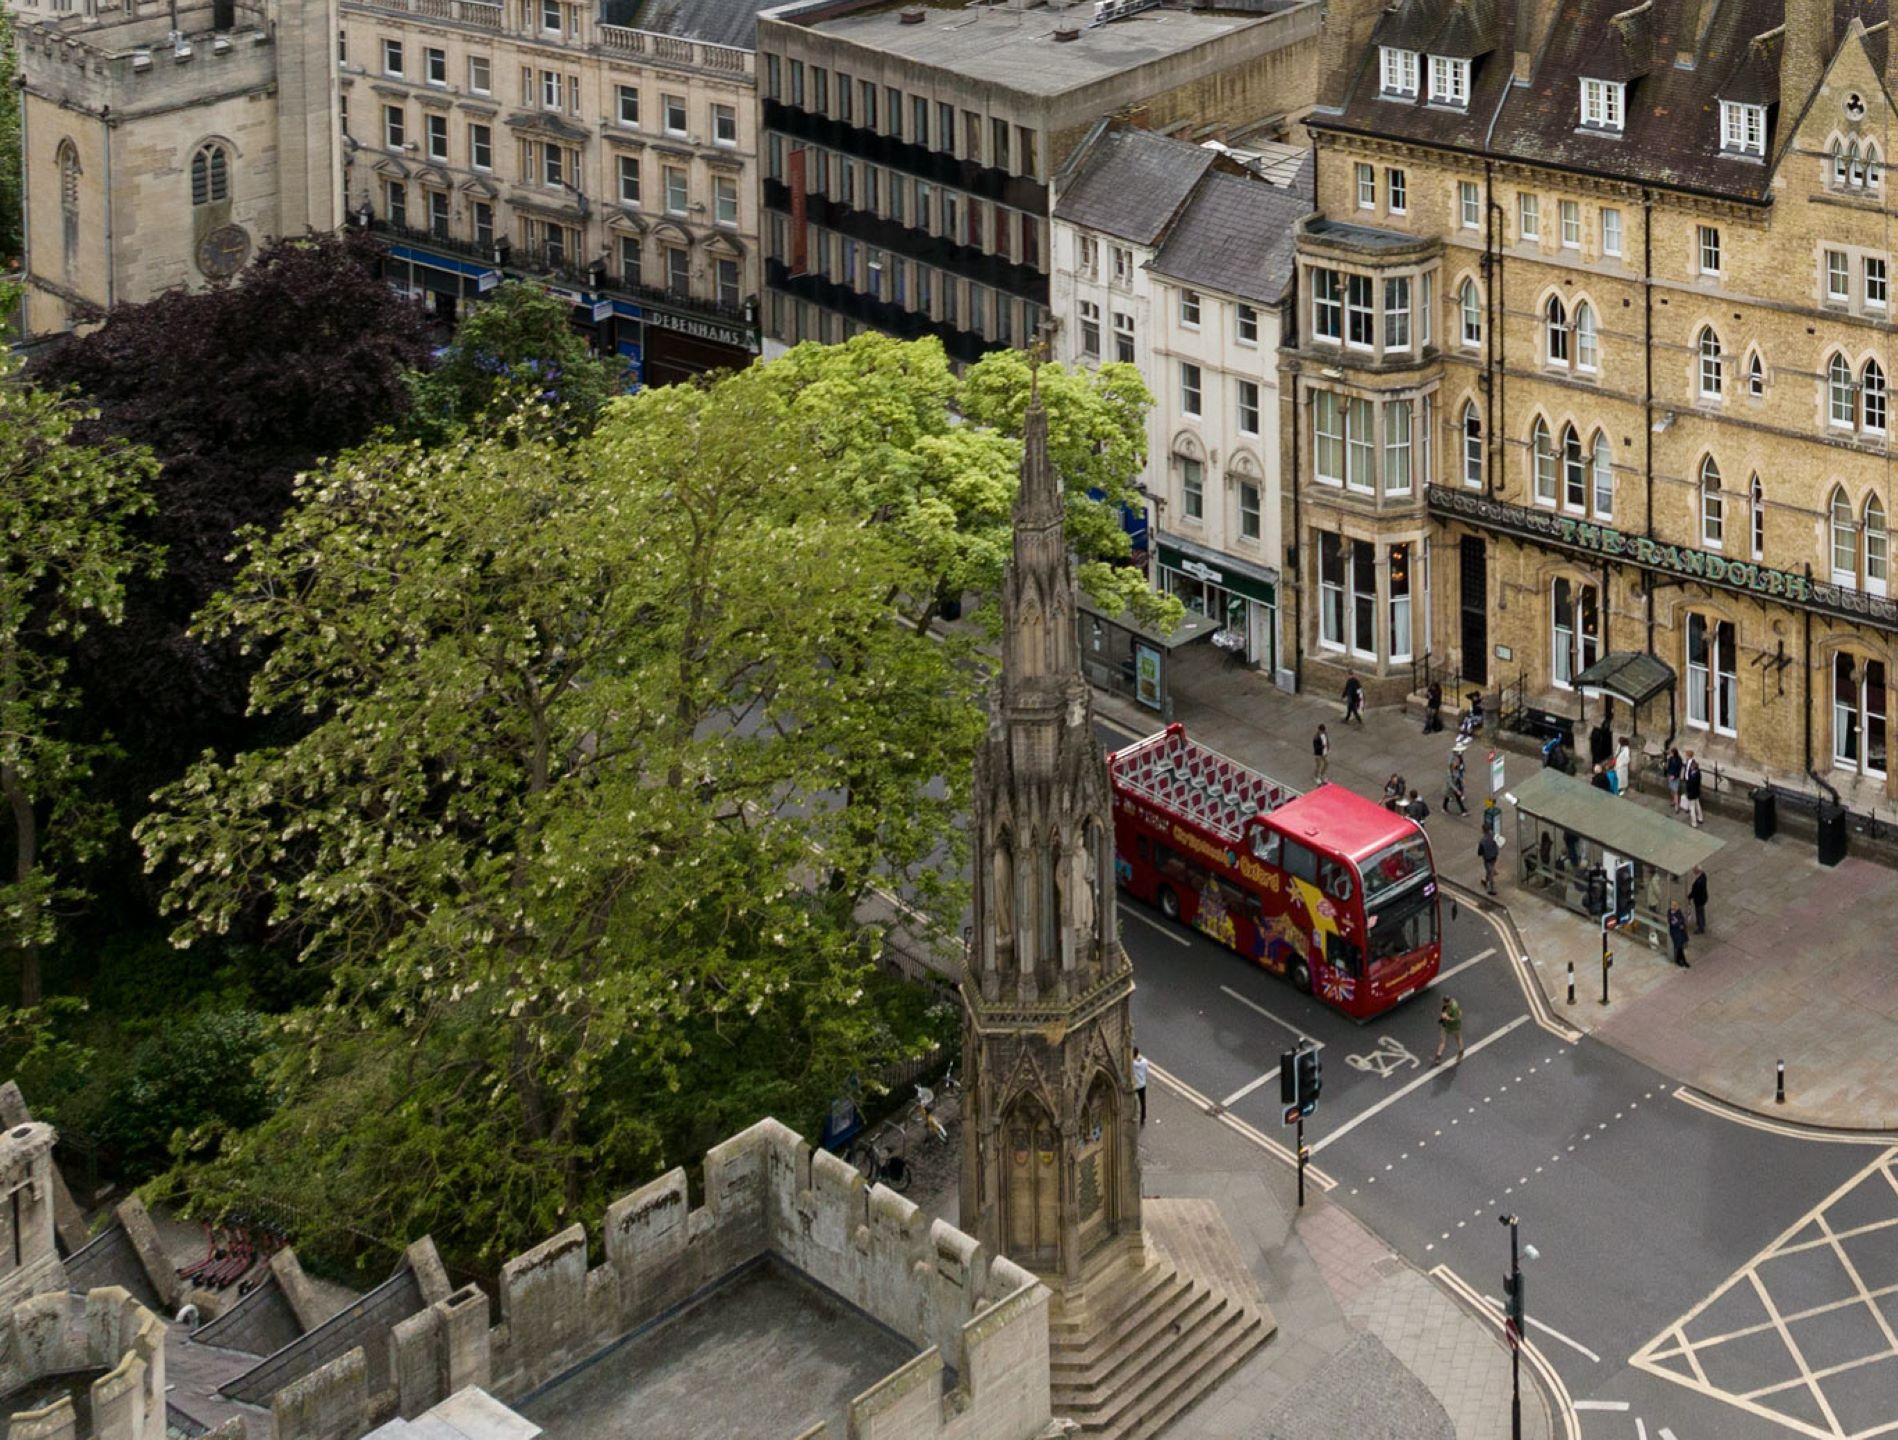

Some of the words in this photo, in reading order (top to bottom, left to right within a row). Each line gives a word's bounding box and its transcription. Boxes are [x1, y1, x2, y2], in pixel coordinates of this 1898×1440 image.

[652, 312, 740, 345] DEBENHAMS
[1557, 516, 1621, 554] THE
[1635, 537, 1811, 602] RANDOLPH
